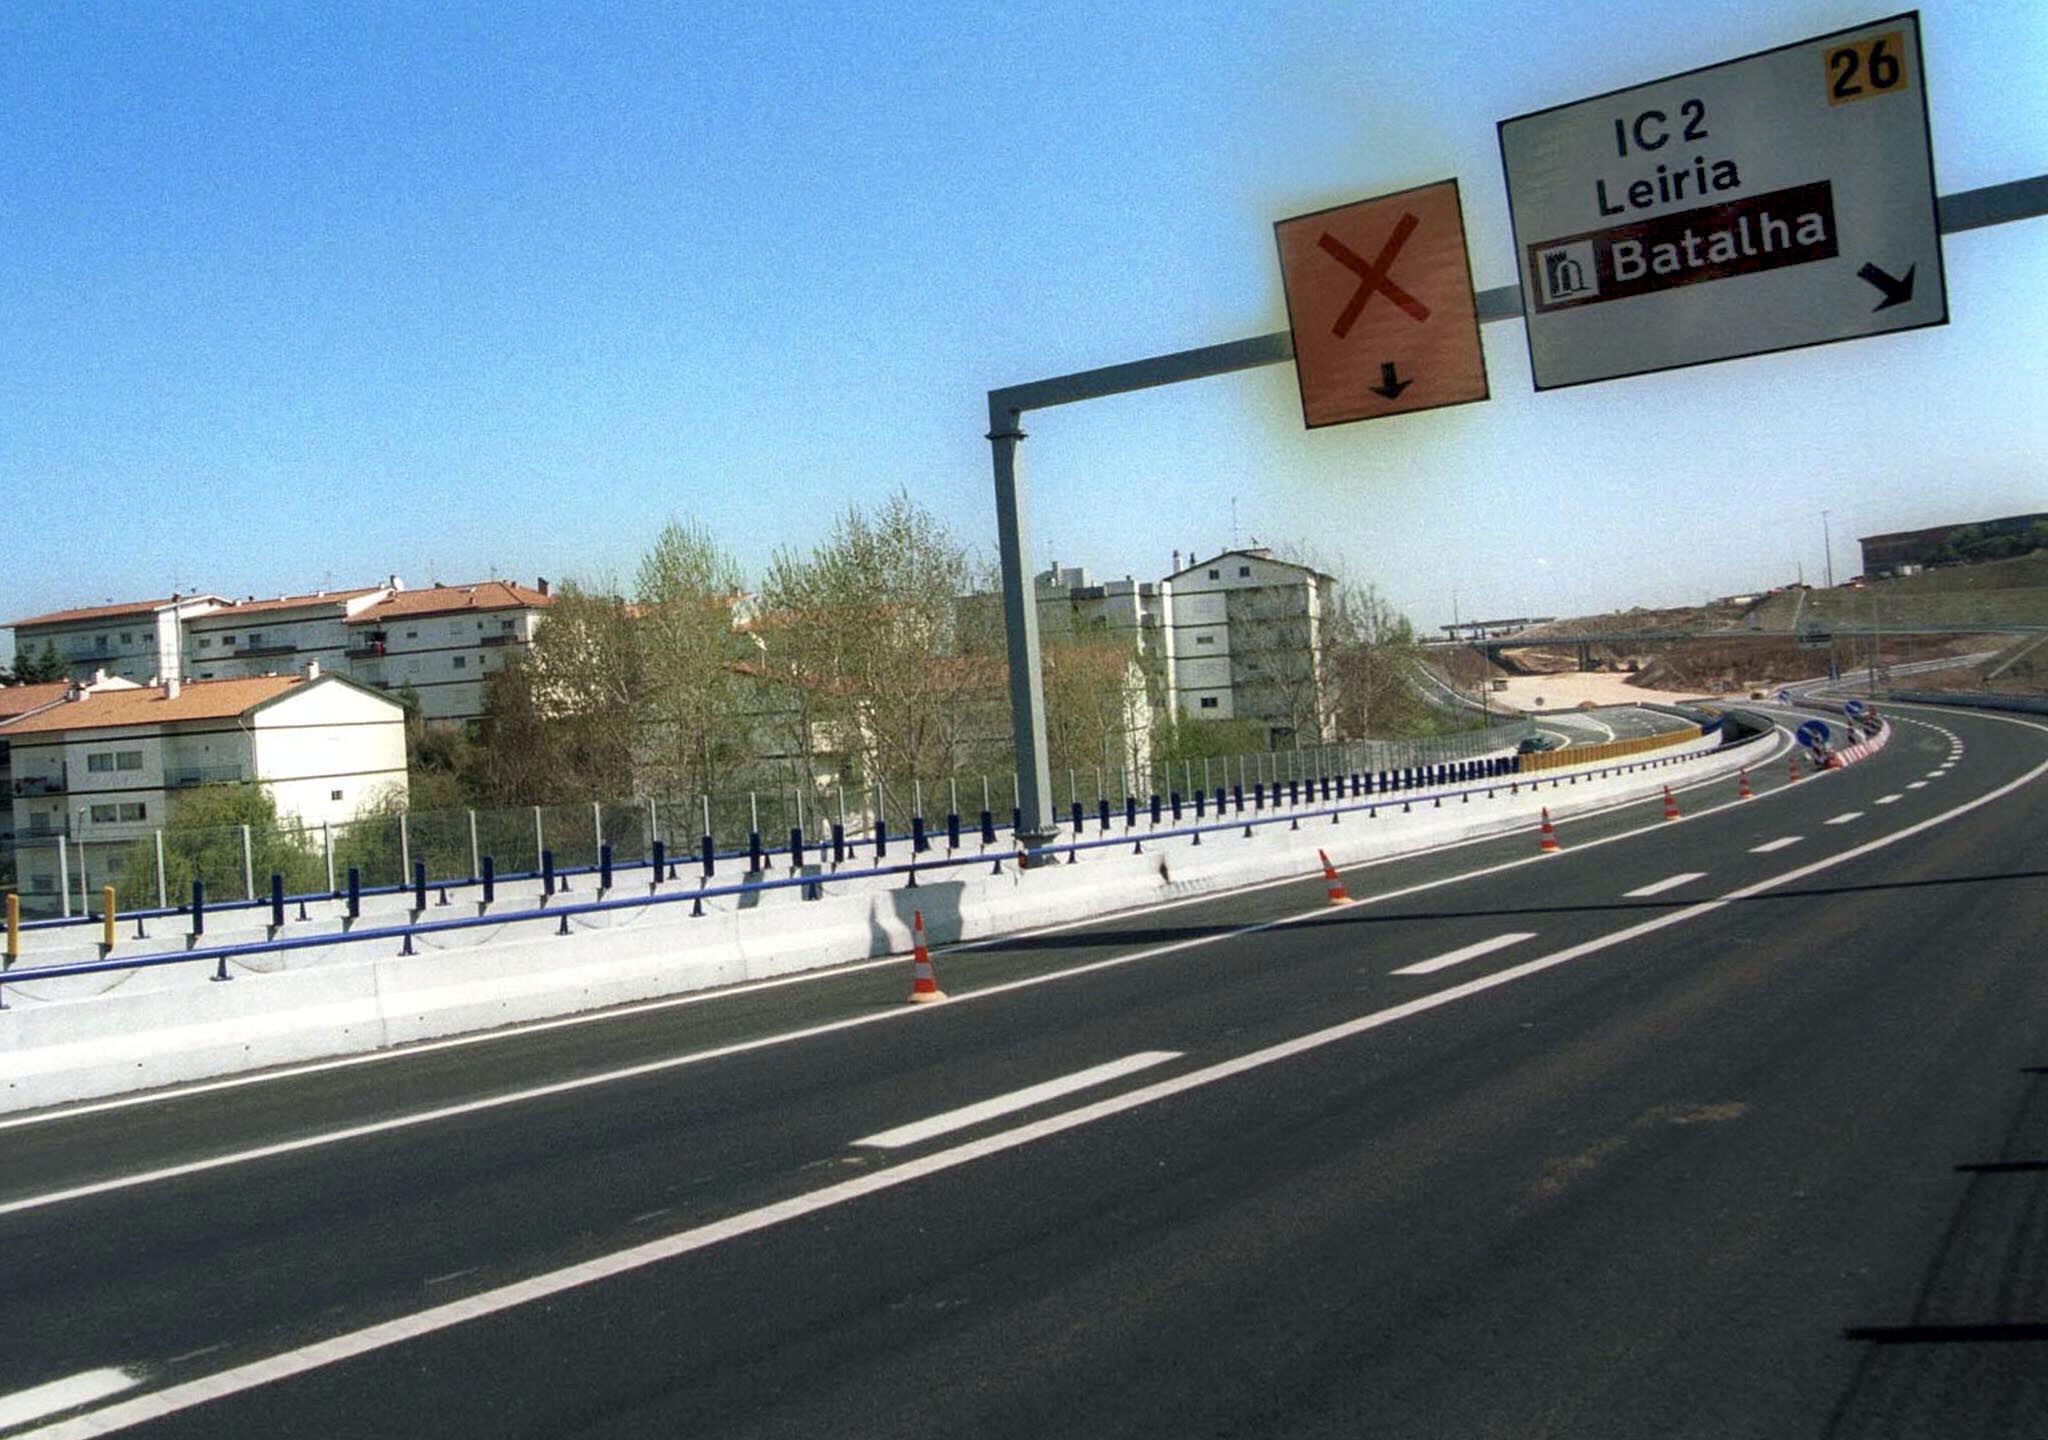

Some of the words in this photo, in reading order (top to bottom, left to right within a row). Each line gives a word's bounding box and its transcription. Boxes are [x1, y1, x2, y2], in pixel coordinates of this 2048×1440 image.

[1831, 40, 1900, 99] 26
[1614, 109, 1669, 158] IC
[1681, 98, 1708, 142] 2
[1596, 155, 1741, 216] Leiria
[1611, 211, 1827, 282] Batalha
